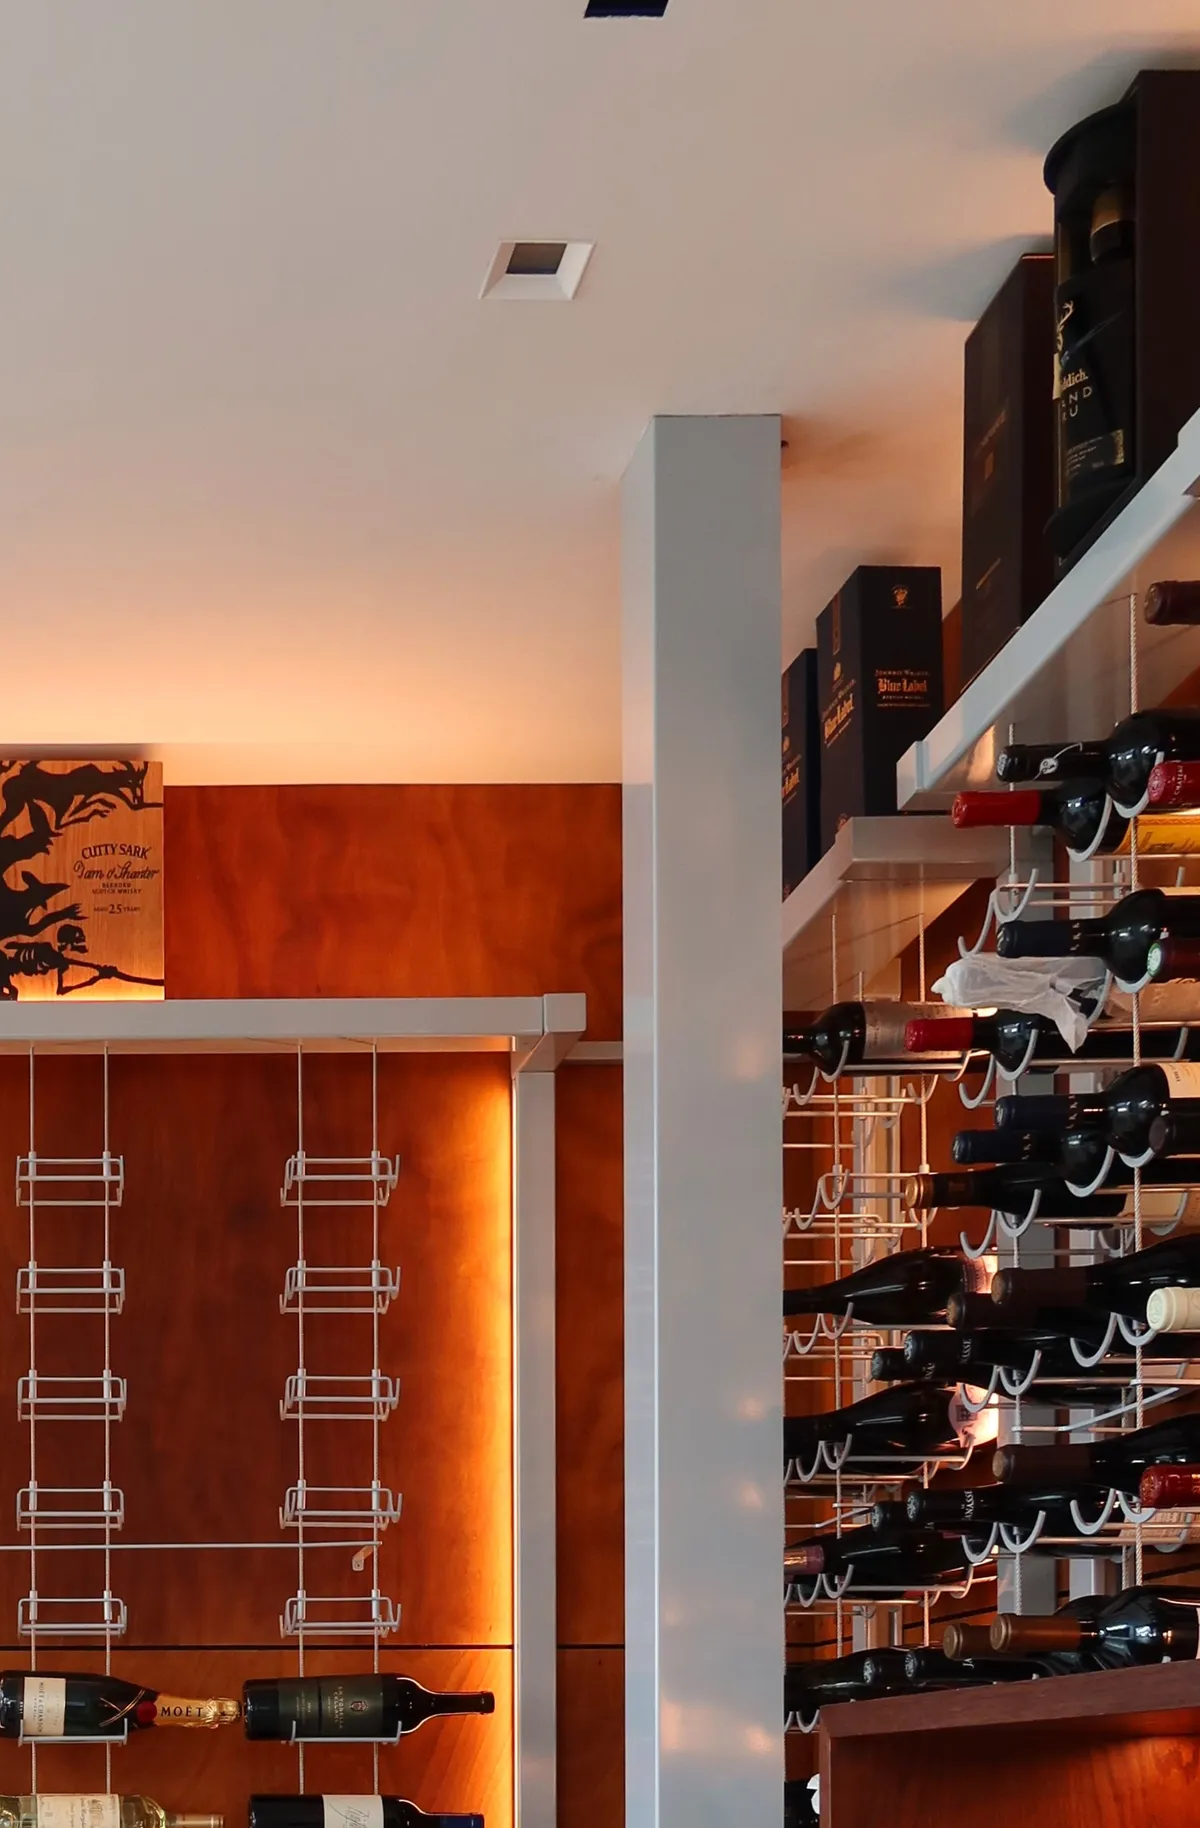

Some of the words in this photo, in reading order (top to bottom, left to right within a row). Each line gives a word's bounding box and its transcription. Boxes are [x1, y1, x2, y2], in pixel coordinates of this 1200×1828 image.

[81, 843, 117, 860] CUTTY
[118, 843, 150, 860] SARK
[73, 860, 104, 880] Tam
[109, 903, 122, 914] 25
